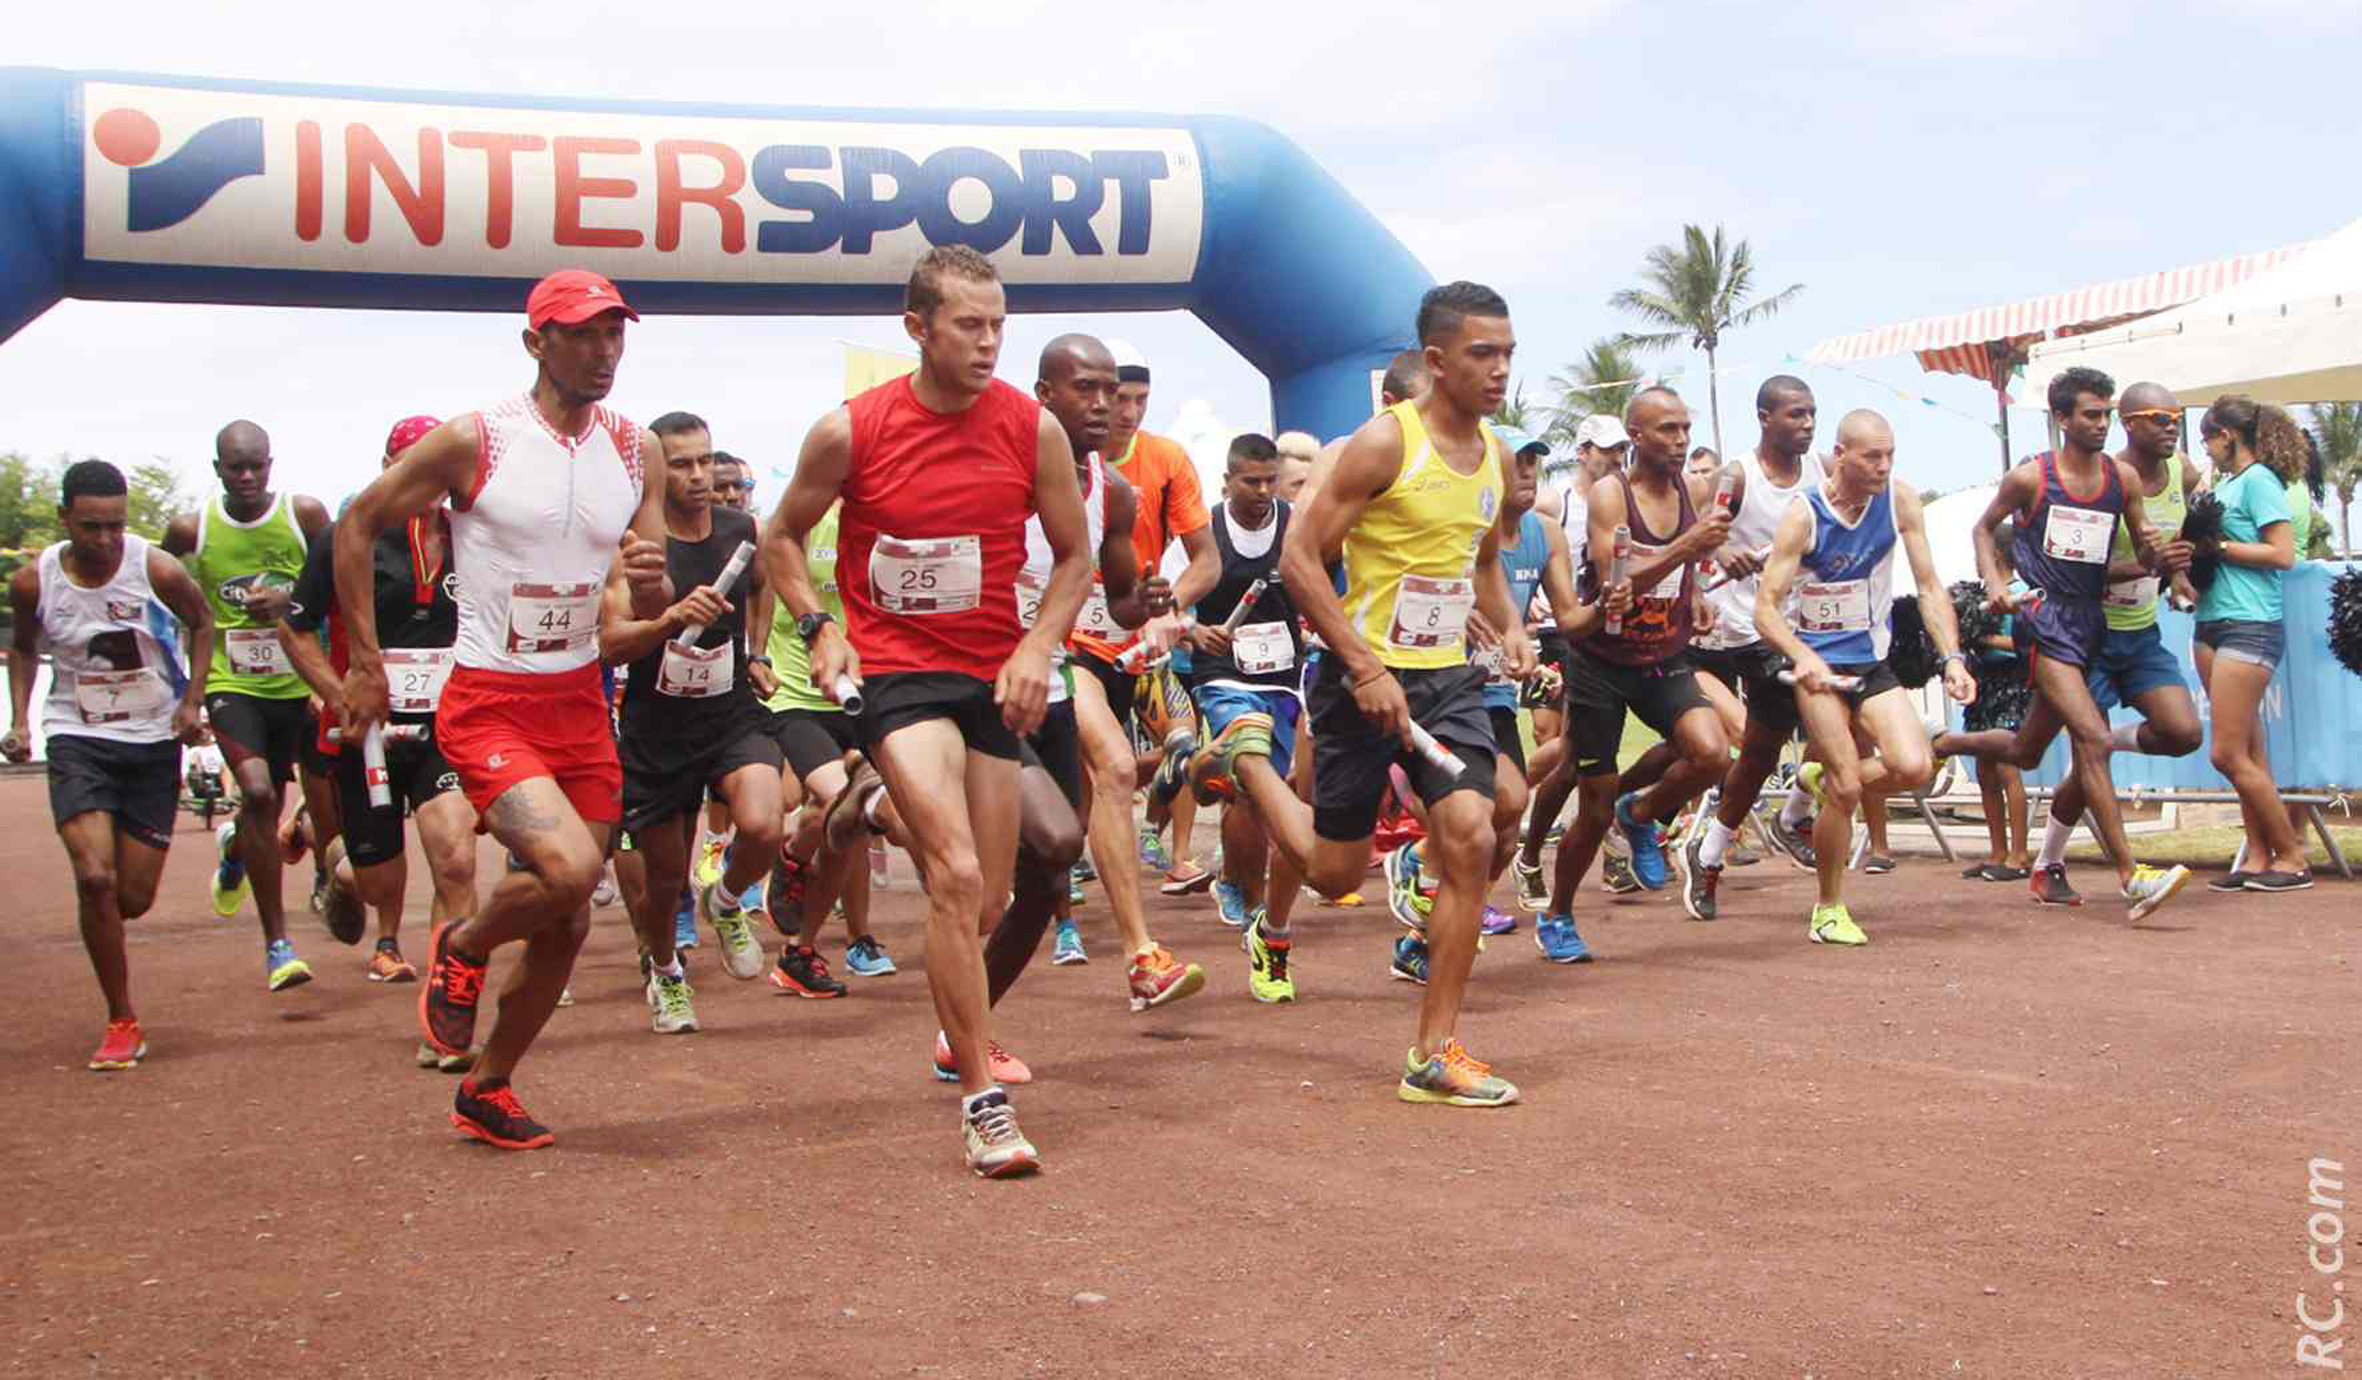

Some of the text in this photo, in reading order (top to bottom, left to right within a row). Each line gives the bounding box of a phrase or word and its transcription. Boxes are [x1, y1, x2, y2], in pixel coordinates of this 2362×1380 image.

[294, 118, 1170, 256] INTERSPORT
[2071, 528, 2083, 545] 3
[900, 569, 937, 590] 25
[1427, 606, 1440, 627] 8
[1820, 602, 1840, 618] 51
[538, 610, 571, 631] 44
[248, 646, 273, 661] 30
[1259, 643, 1269, 657] 9
[404, 673, 431, 692] 27
[686, 667, 709, 682] 14
[108, 688, 121, 707] 7
